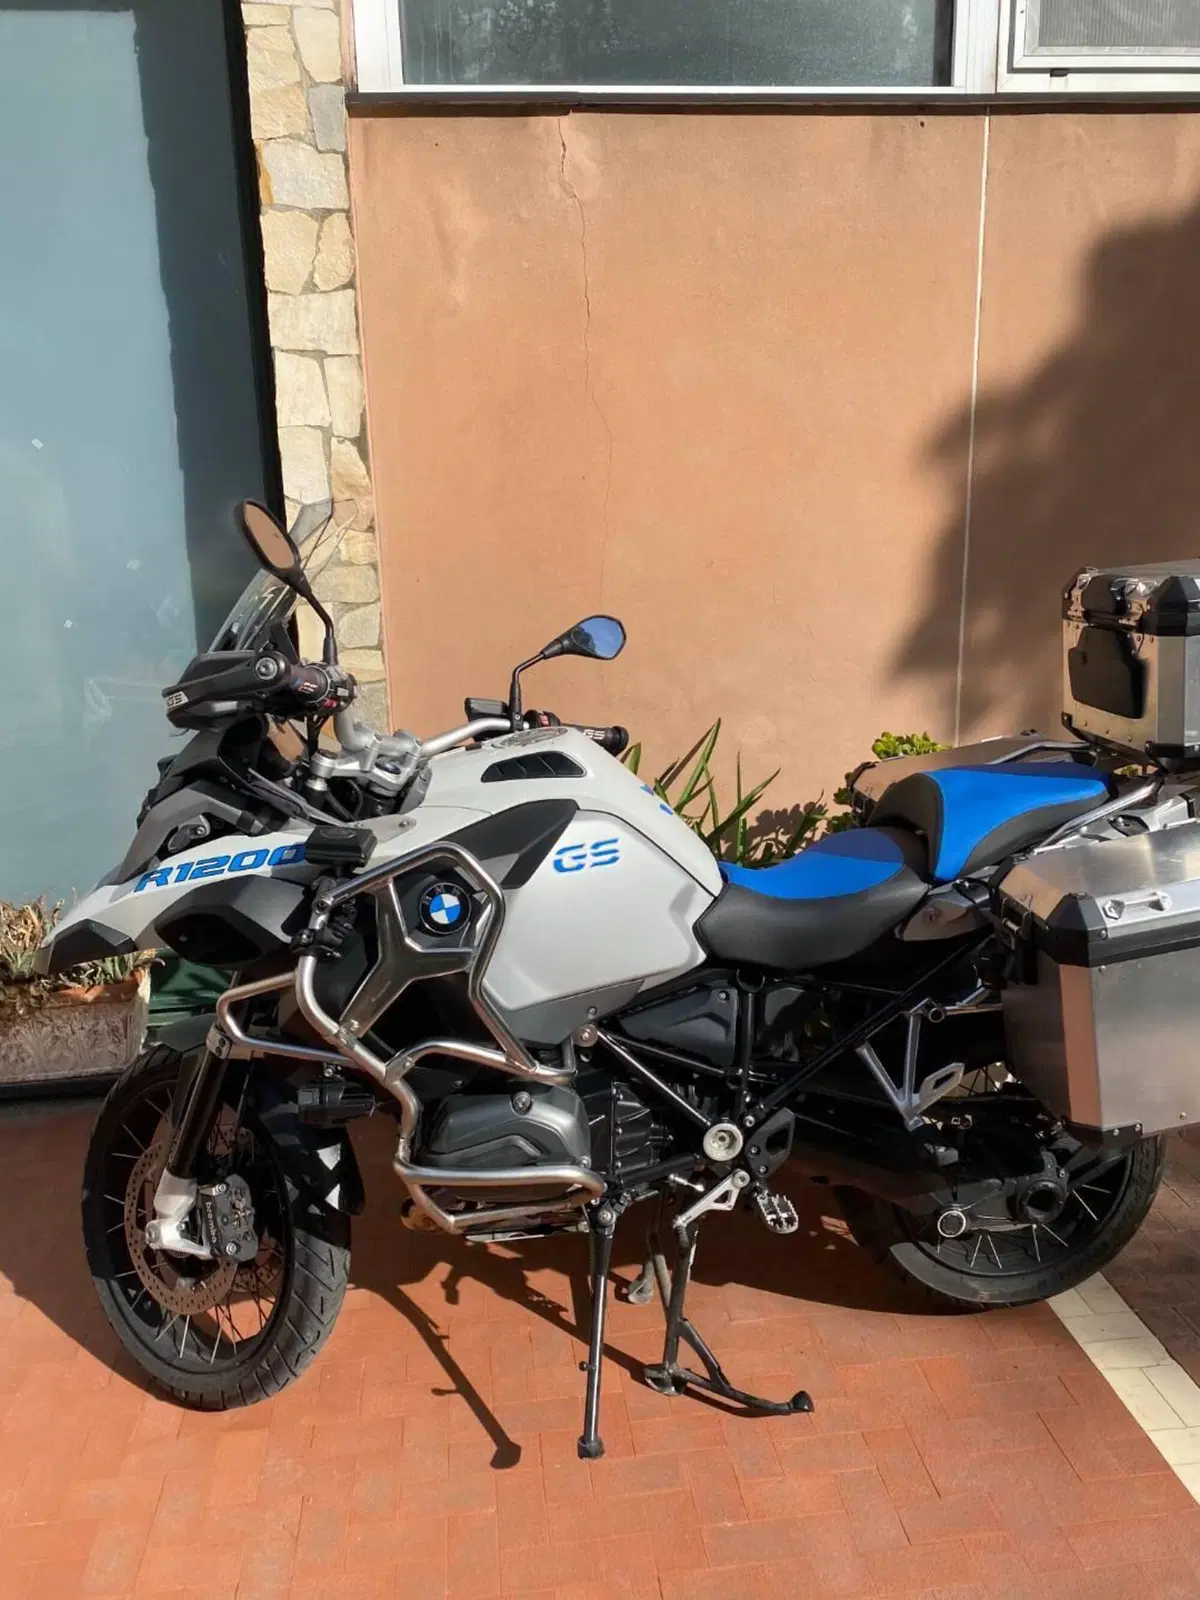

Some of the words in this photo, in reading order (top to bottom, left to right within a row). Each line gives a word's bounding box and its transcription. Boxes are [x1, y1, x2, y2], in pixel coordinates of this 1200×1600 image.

[583, 729, 606, 740] GS
[134, 842, 306, 893] R1200
[553, 838, 620, 873] GS
[205, 1201, 217, 1243] brembo
